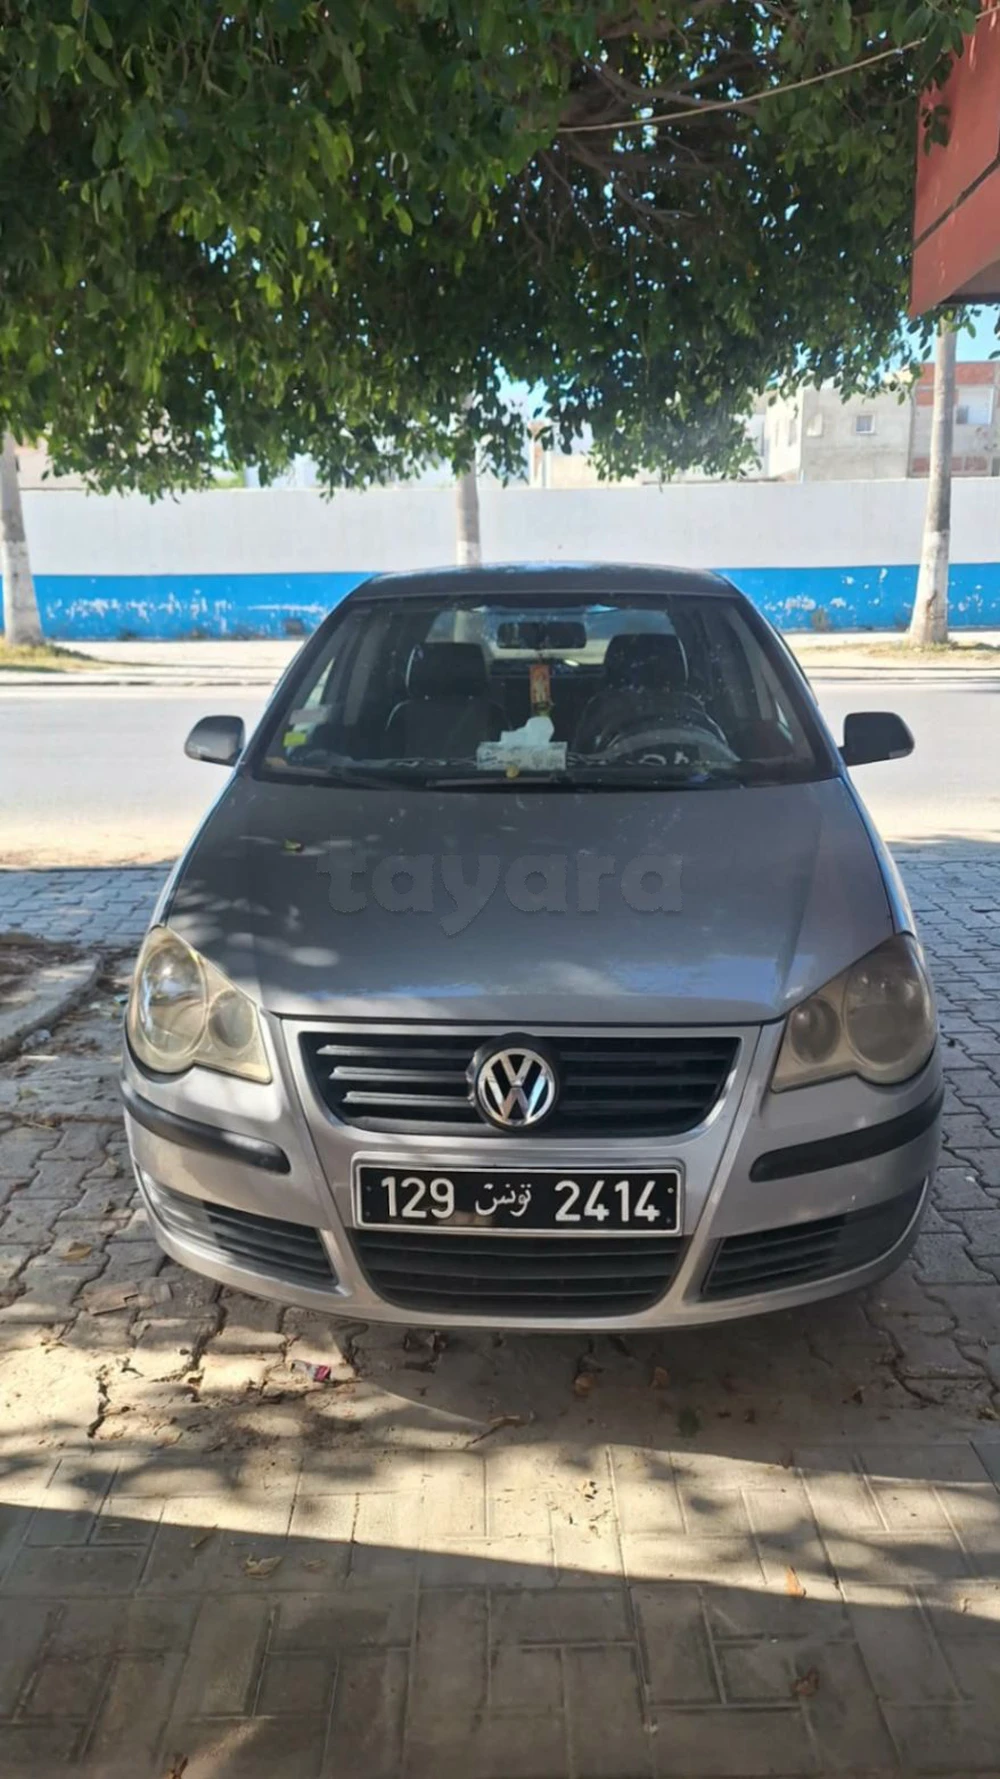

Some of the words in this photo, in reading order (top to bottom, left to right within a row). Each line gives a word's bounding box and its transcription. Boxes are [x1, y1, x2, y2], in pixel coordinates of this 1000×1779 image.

[480, 1050, 552, 1123] VW
[380, 1176, 455, 1219] 129
[475, 1182, 532, 1217] تونس
[554, 1179, 661, 1222] 2414
